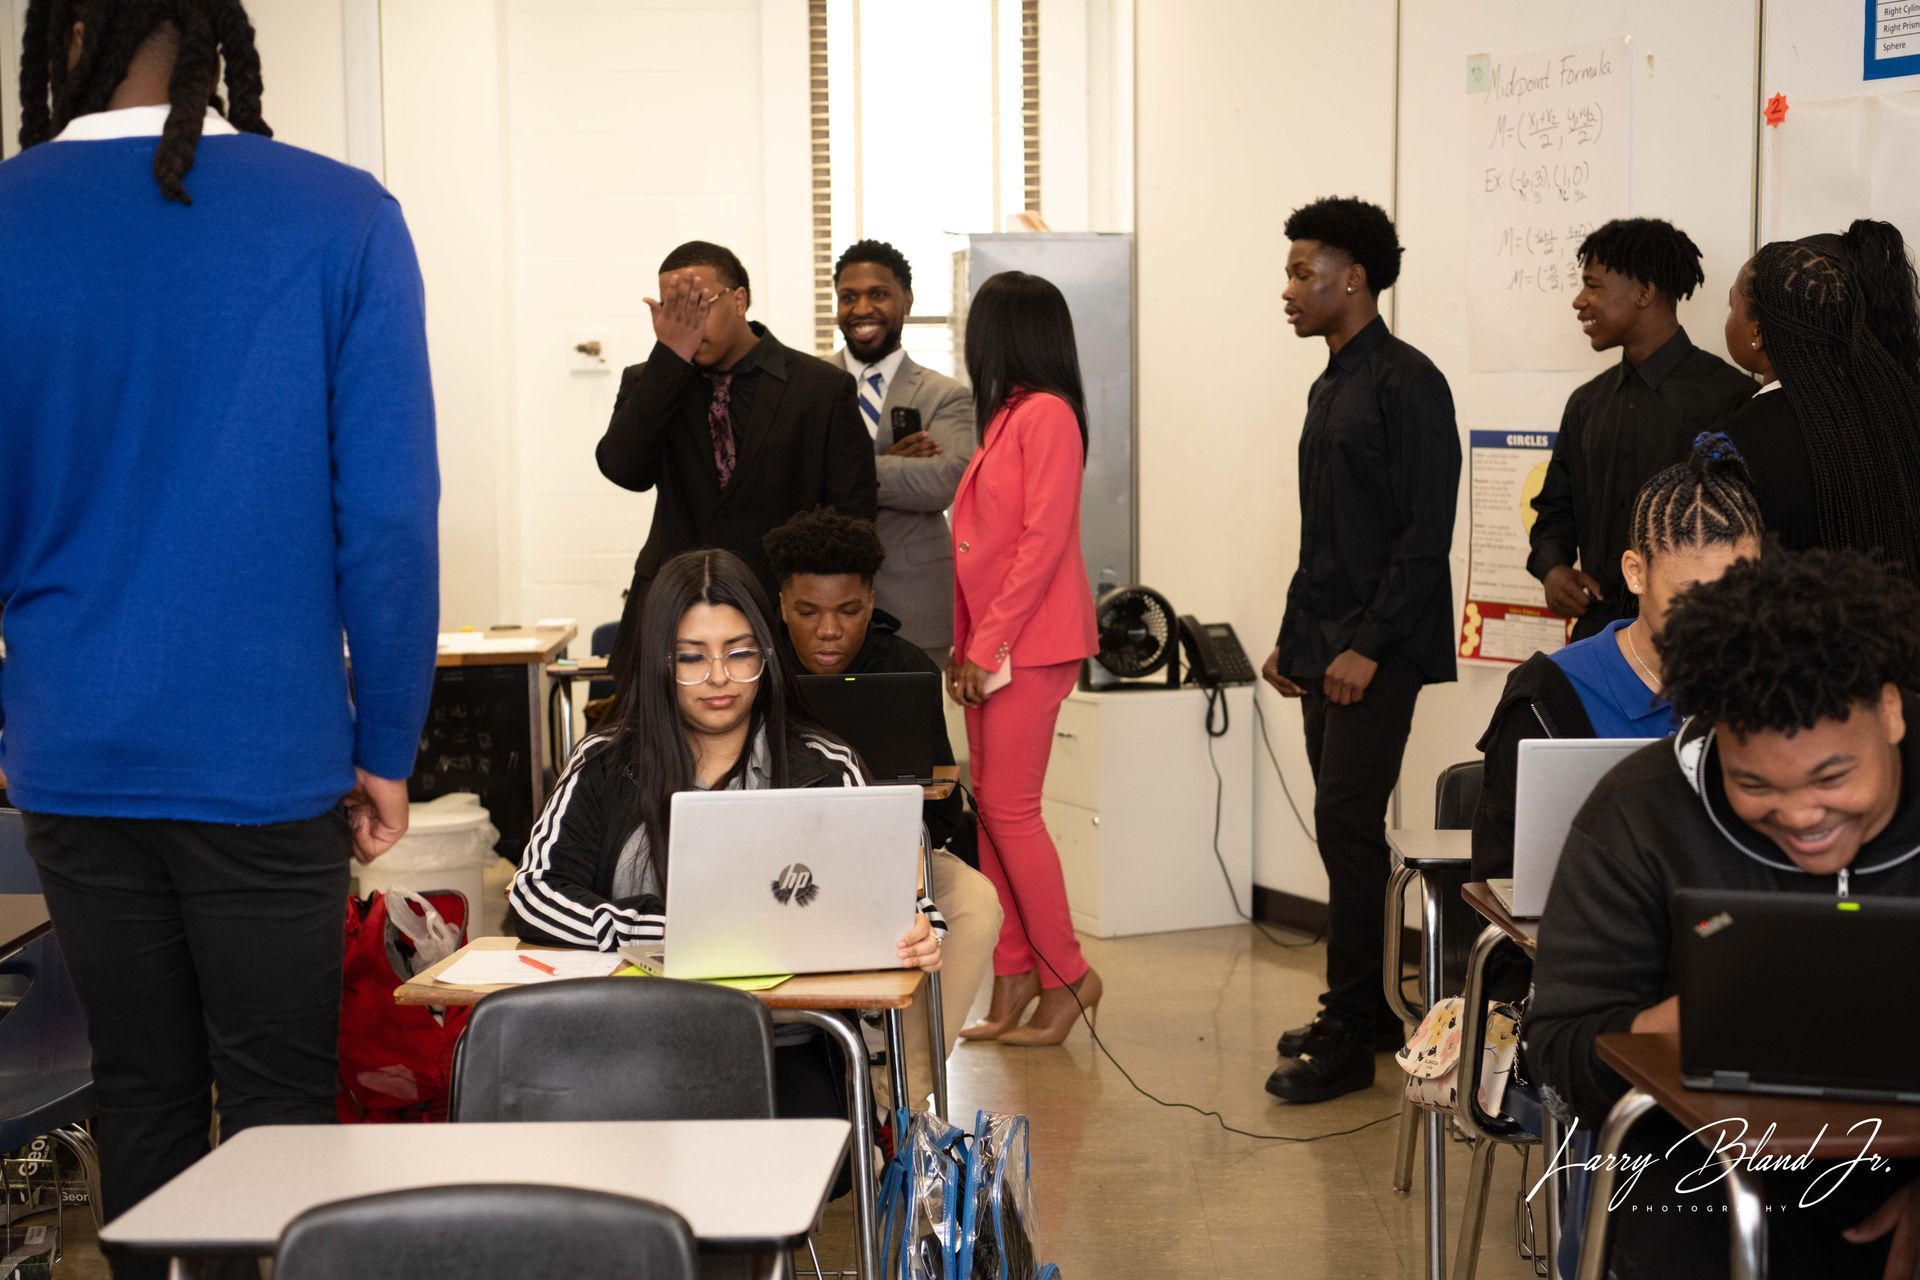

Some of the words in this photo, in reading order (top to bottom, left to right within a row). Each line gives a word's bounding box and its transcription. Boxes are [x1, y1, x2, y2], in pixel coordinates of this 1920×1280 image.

[1884, 7, 1902, 17] Right
[1883, 24, 1901, 34] Right
[1882, 41, 1906, 52] Sphere
[1559, 49, 1612, 88] Formula
[1771, 98, 1782, 114] 2
[1506, 434, 1549, 448] CIRCLES
